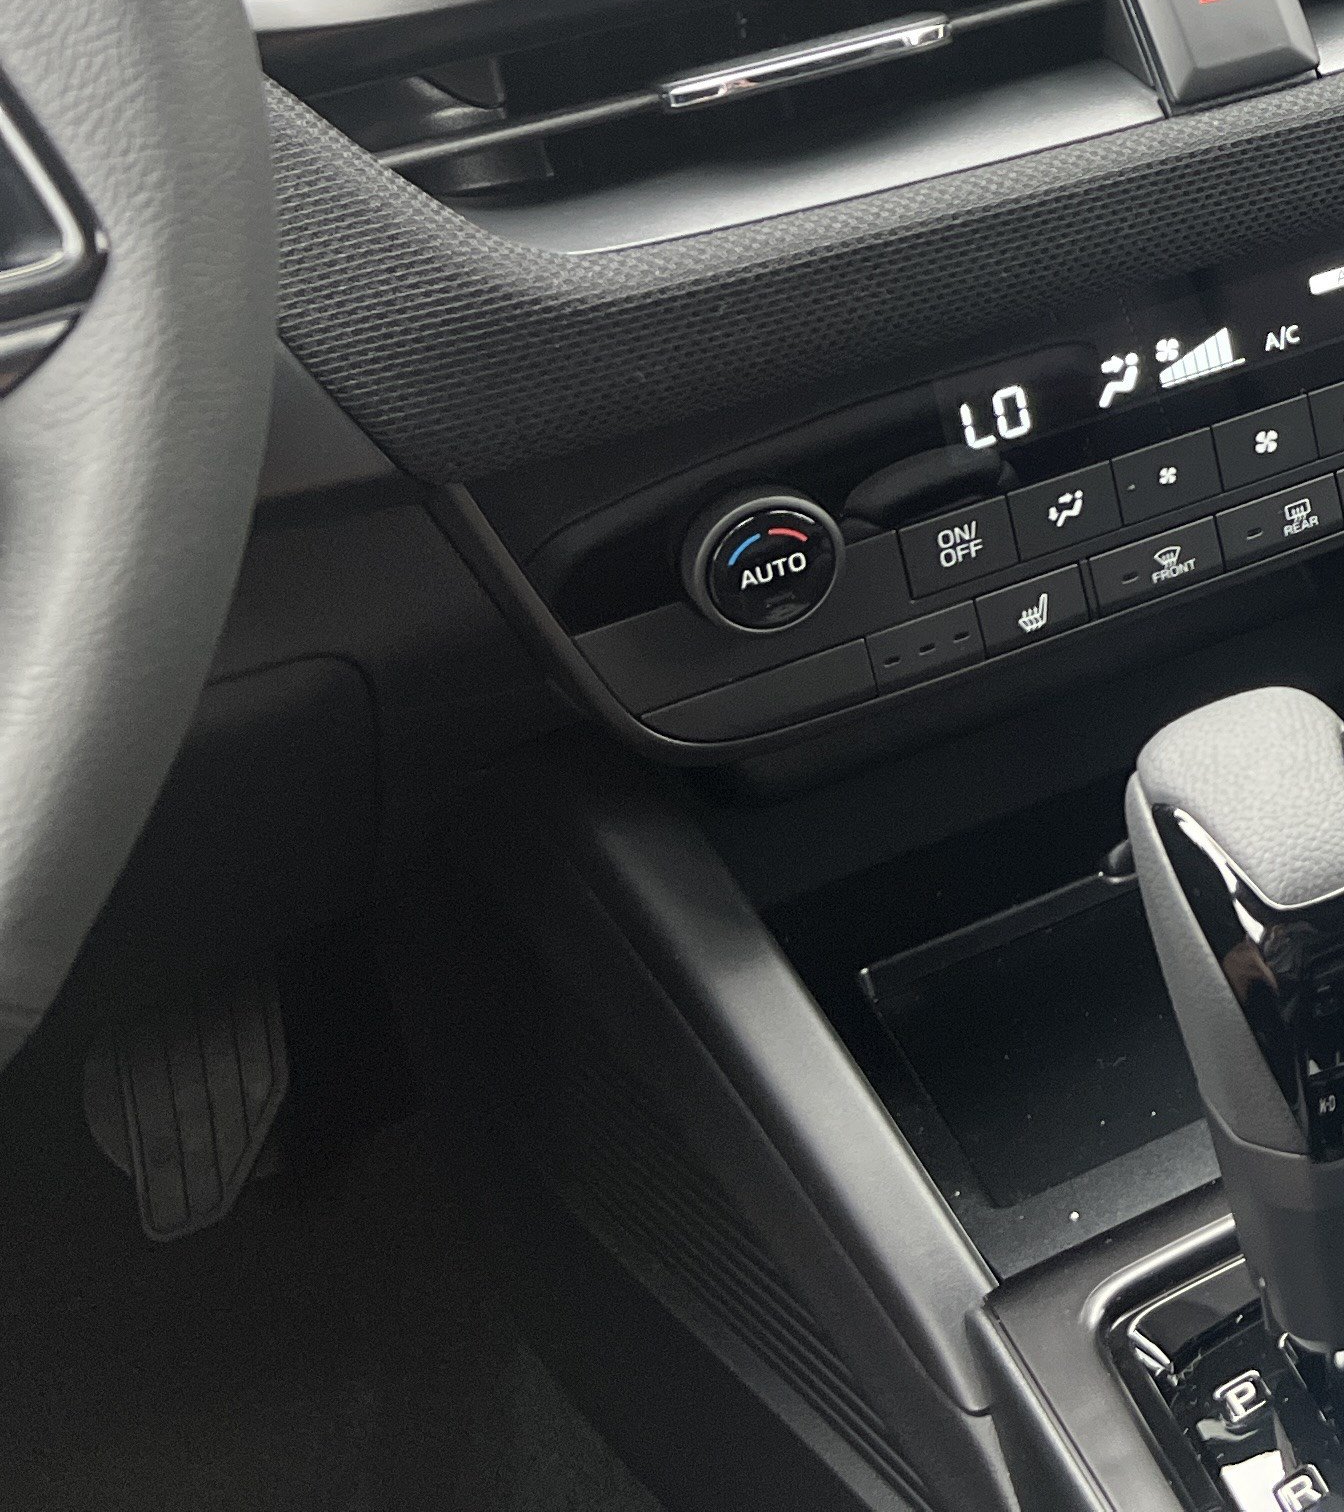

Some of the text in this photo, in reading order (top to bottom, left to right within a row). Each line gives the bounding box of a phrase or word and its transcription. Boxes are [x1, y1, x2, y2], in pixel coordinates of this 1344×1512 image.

[1264, 325, 1301, 352] A/C
[959, 385, 1033, 450] LO
[937, 519, 979, 548] ON/
[1283, 515, 1319, 538] REAR
[939, 538, 983, 569] OFF
[740, 551, 808, 591] AUTO
[1151, 557, 1196, 584] FRONT
[1227, 1381, 1258, 1419] P
[1278, 1474, 1322, 1511] R
